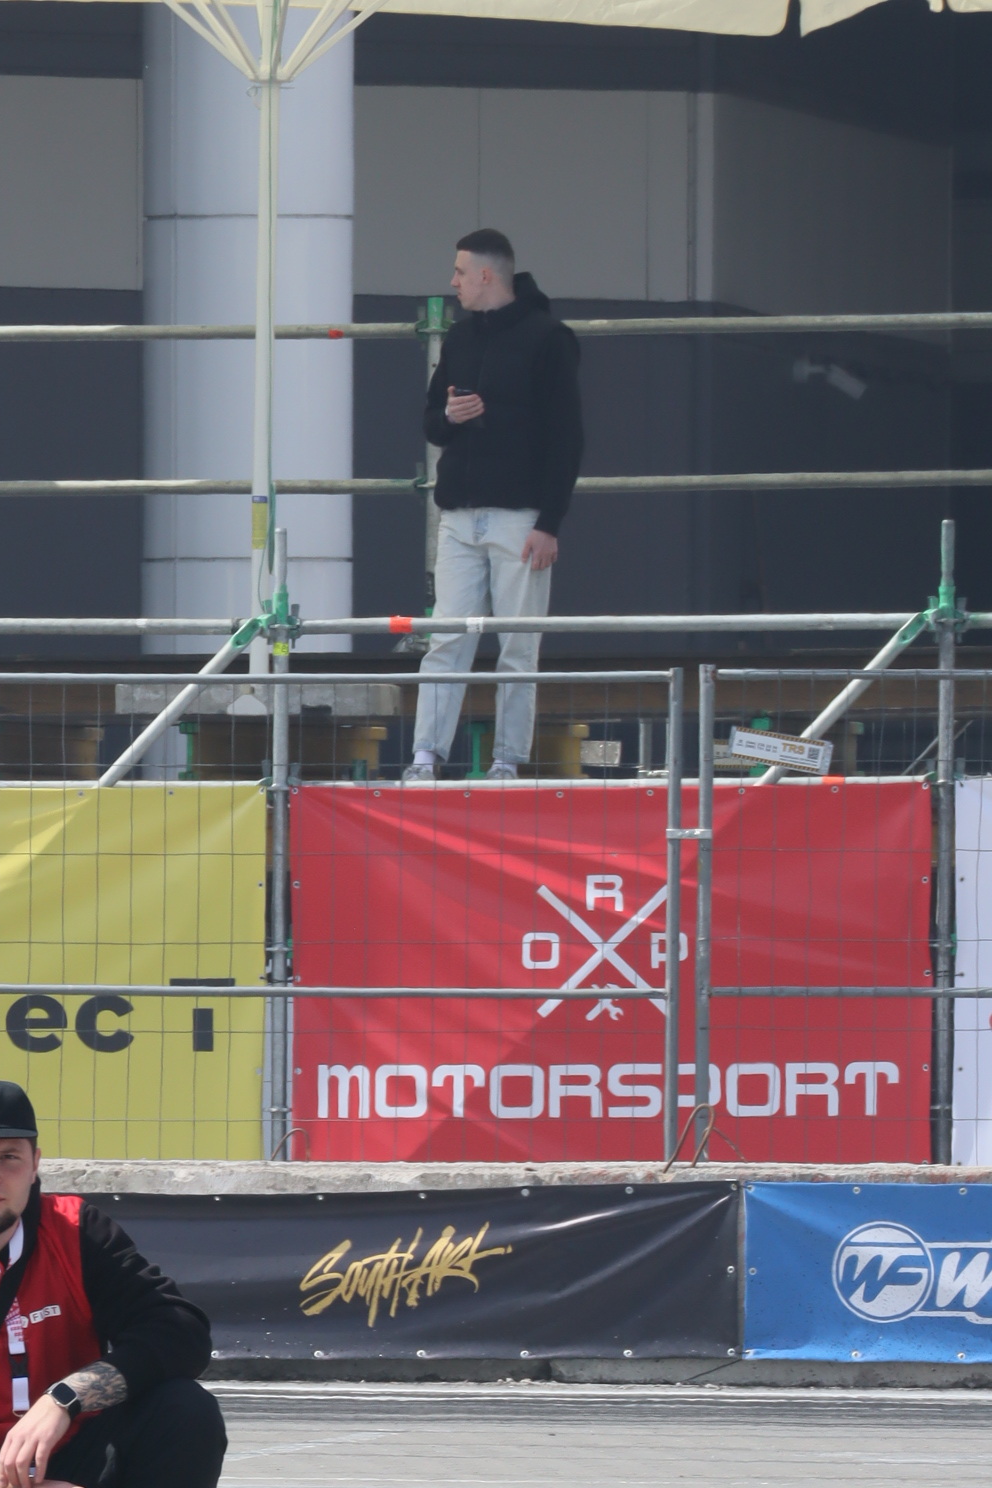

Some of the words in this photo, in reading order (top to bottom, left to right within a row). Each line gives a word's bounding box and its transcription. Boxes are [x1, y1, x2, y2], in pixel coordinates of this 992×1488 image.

[781, 743, 806, 755] TRS
[585, 874, 624, 911] R
[521, 932, 560, 969] O
